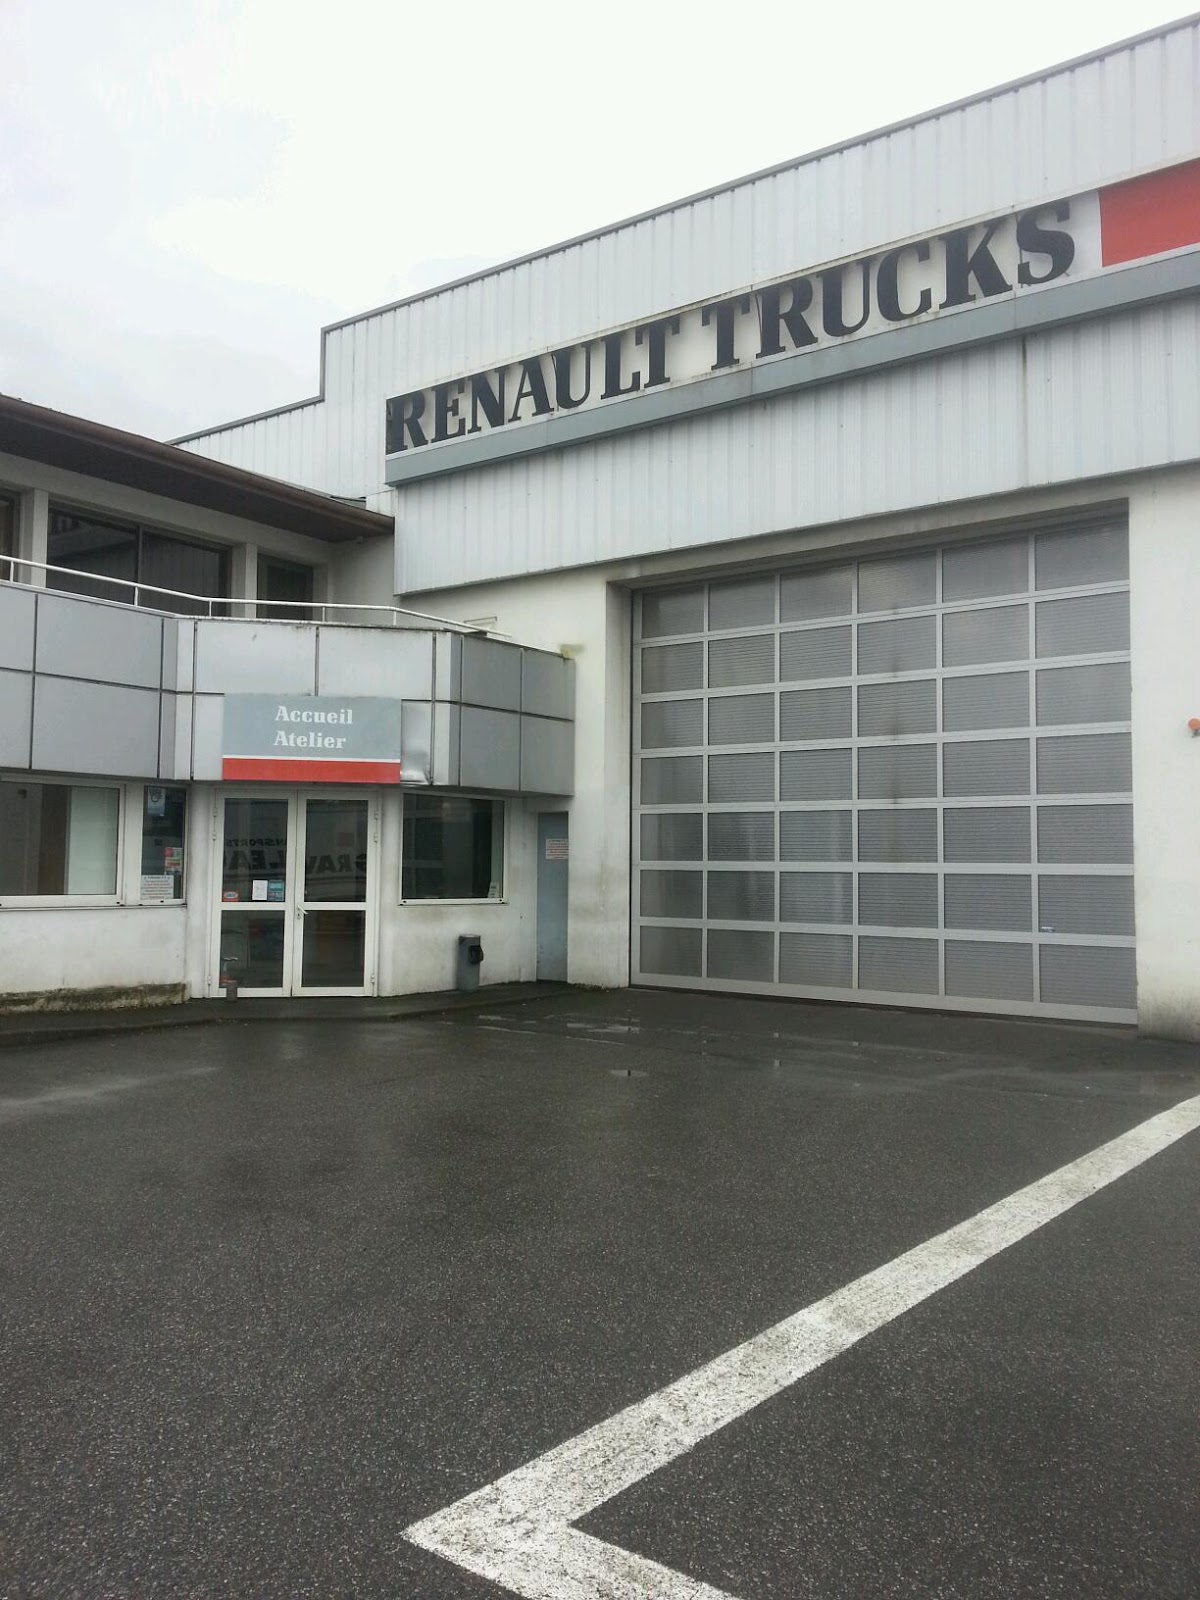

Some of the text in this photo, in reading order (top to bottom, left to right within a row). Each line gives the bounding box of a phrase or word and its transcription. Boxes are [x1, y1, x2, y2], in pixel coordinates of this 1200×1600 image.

[385, 200, 1075, 454] RENAULT TRUCKS
[275, 705, 353, 725] Accueil
[273, 731, 347, 749] Atelier
